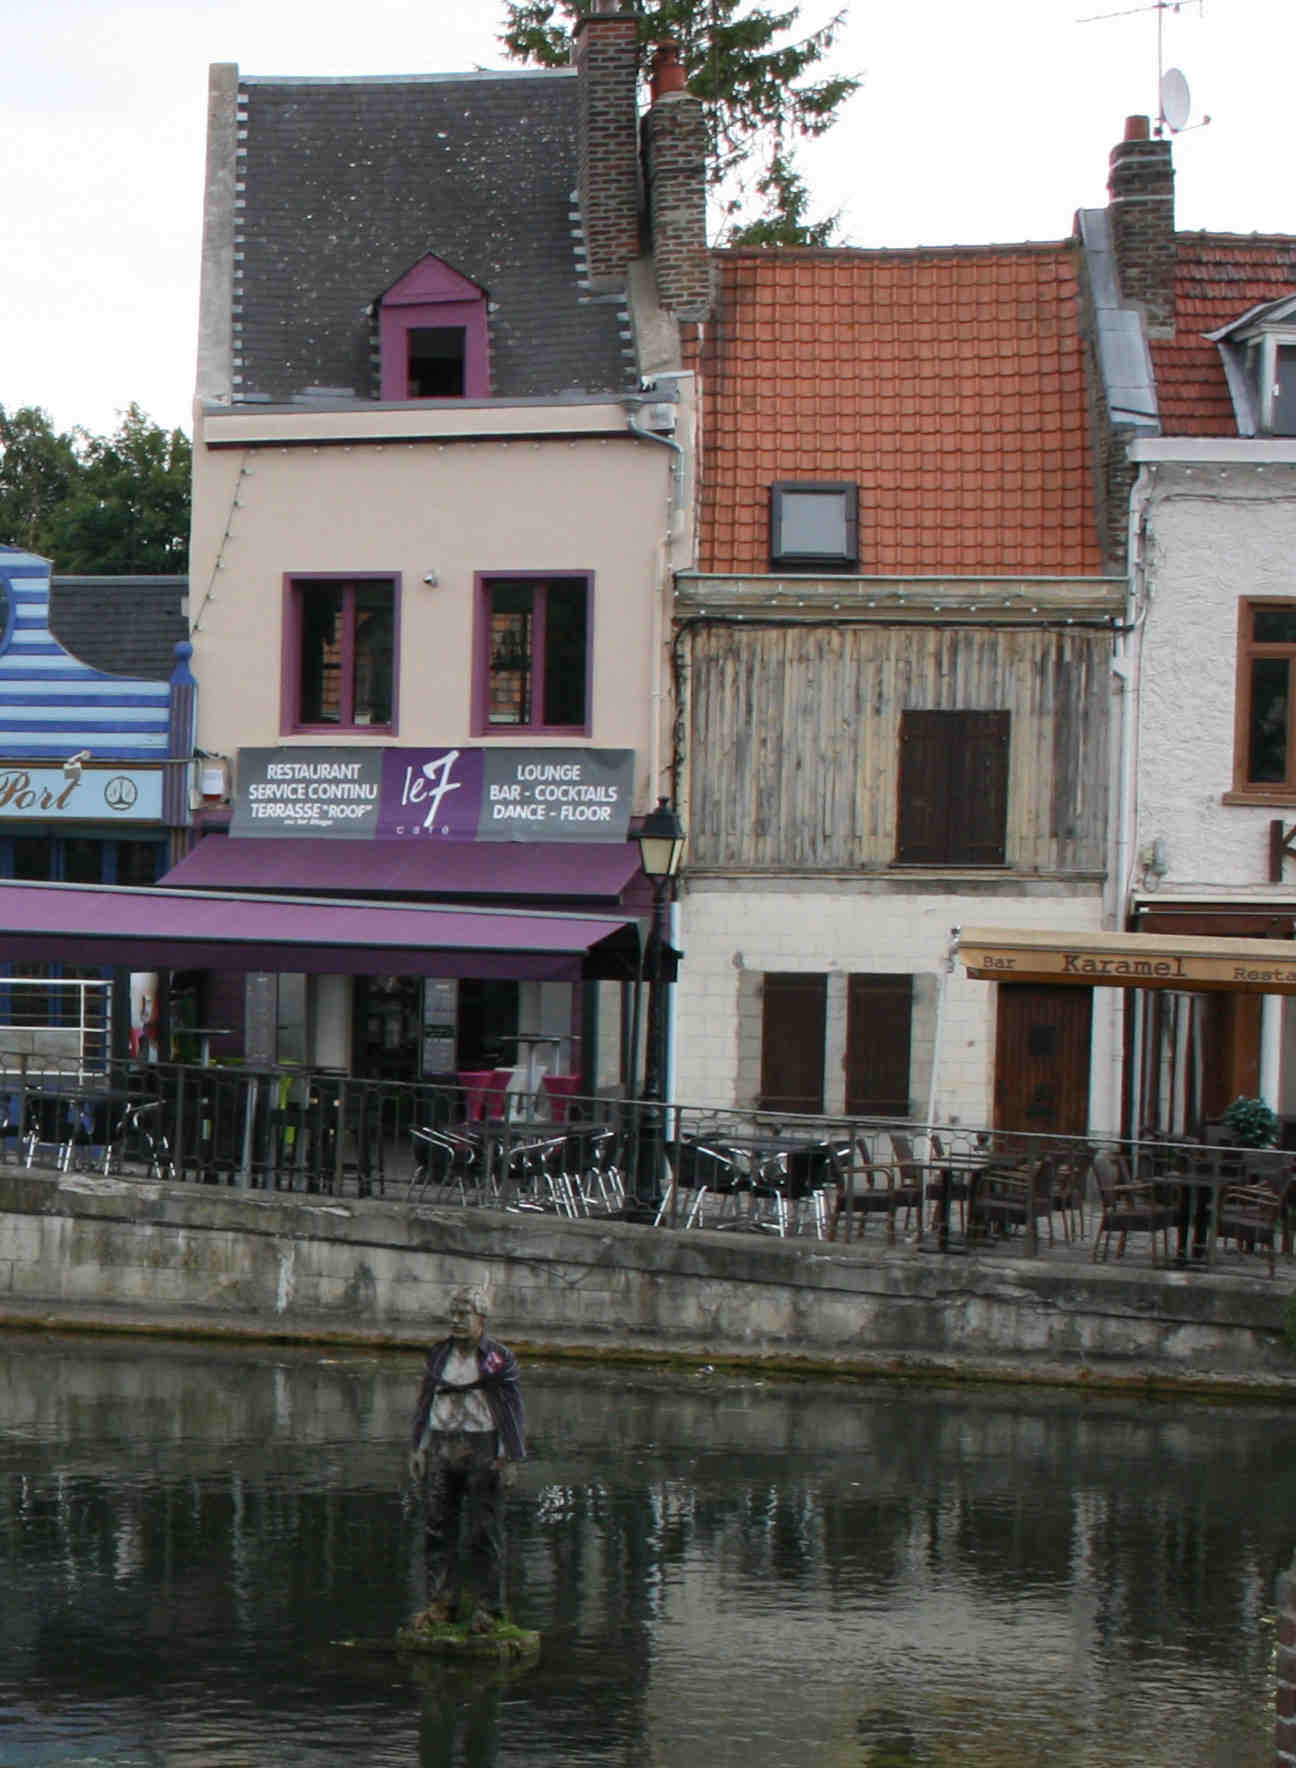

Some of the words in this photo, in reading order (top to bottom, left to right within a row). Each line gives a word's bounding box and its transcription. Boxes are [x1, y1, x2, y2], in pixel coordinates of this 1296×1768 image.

[266, 763, 362, 780] RESTAURANT
[517, 764, 581, 781] LOUNGE
[248, 783, 306, 800] SERVICE
[308, 784, 379, 800] CONTINU
[489, 785, 521, 801] BAR
[535, 785, 618, 803] COCKTAILS
[250, 802, 320, 818] TERRASSE
[493, 804, 546, 820] DANCE
[560, 805, 612, 822] FLOOR
[982, 956, 1017, 969] Bar
[1062, 954, 1187, 978] Karamel
